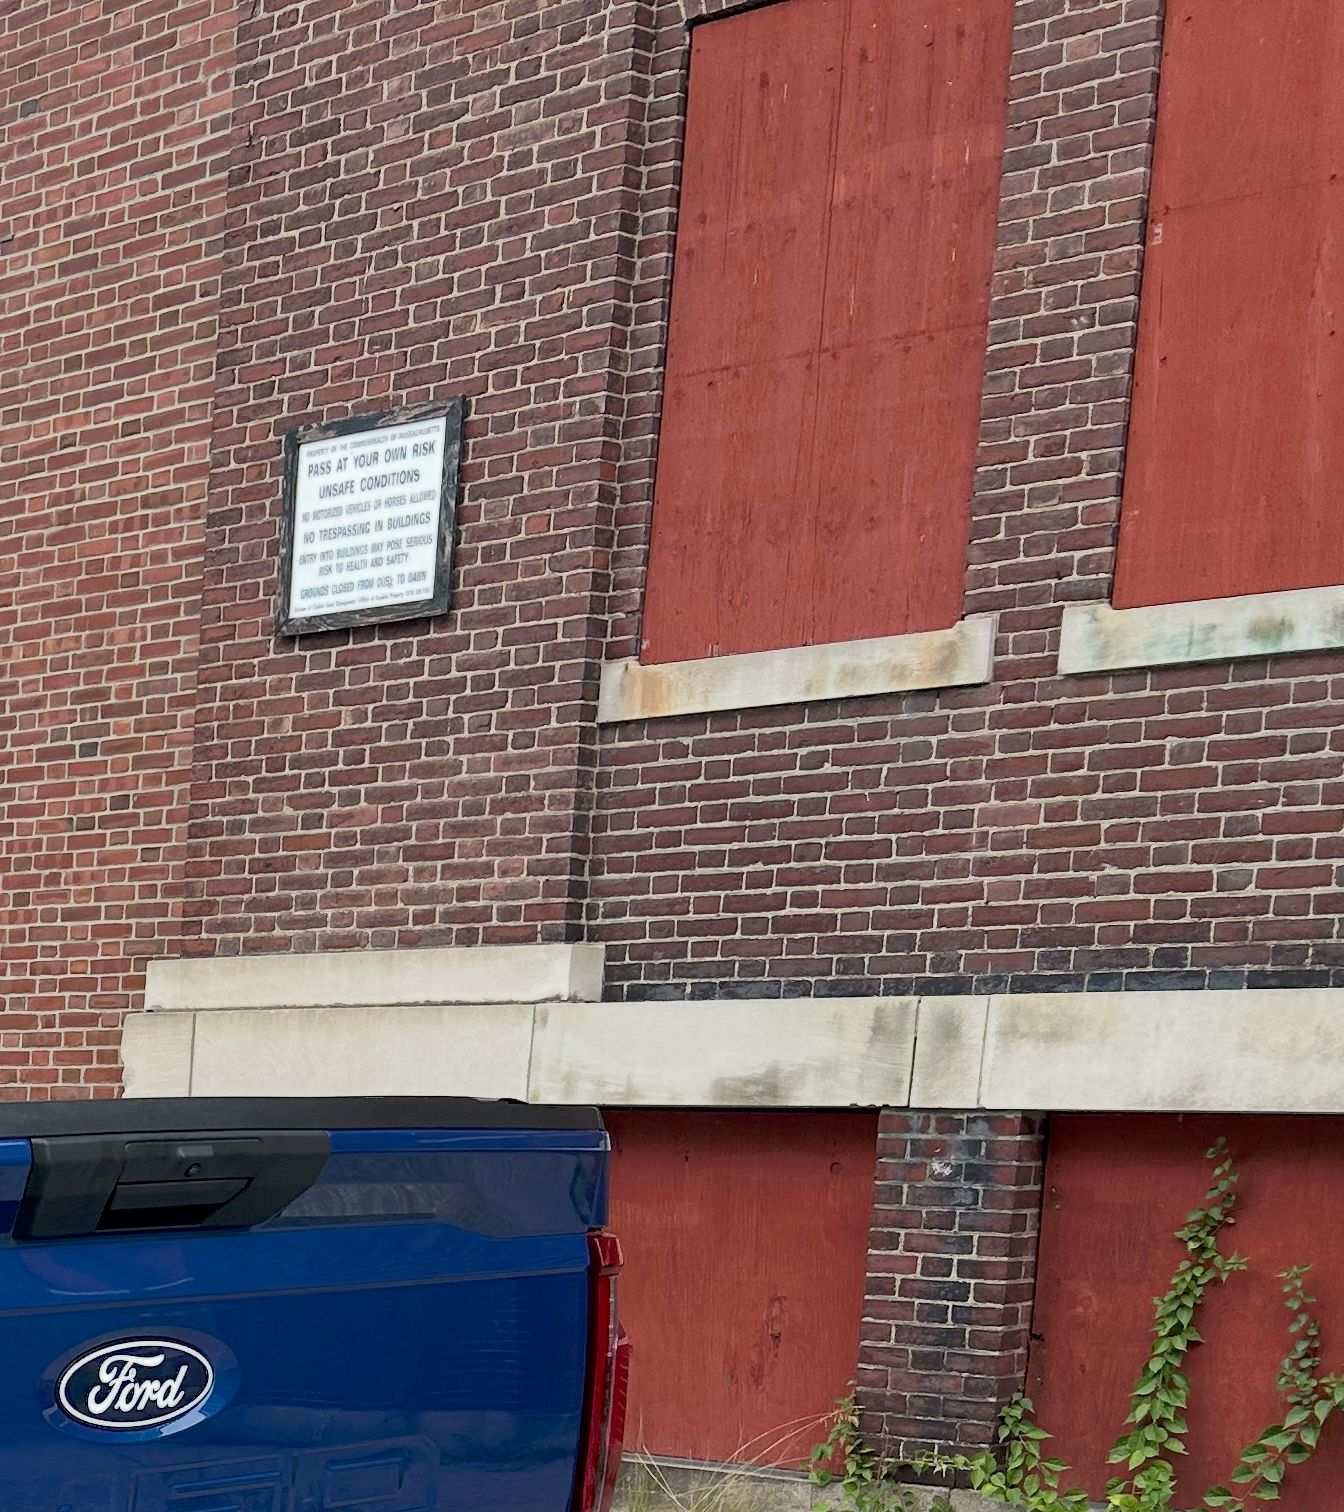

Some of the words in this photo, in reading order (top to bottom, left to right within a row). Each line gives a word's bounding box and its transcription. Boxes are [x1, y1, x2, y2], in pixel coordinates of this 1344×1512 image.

[308, 460, 331, 477] PASS
[336, 457, 347, 472] AT
[352, 450, 378, 468] YOUR
[384, 445, 407, 462] OWN
[412, 439, 435, 457] RISK
[318, 479, 354, 499] UNSAFE
[360, 468, 419, 491] CONDITIONS
[303, 531, 314, 544] NO
[318, 522, 370, 541] TRESPASSING
[374, 519, 383, 532] IN
[387, 511, 430, 530] BUILDINGS
[385, 552, 408, 565] SAFETY
[87, 1353, 188, 1415] Ford
